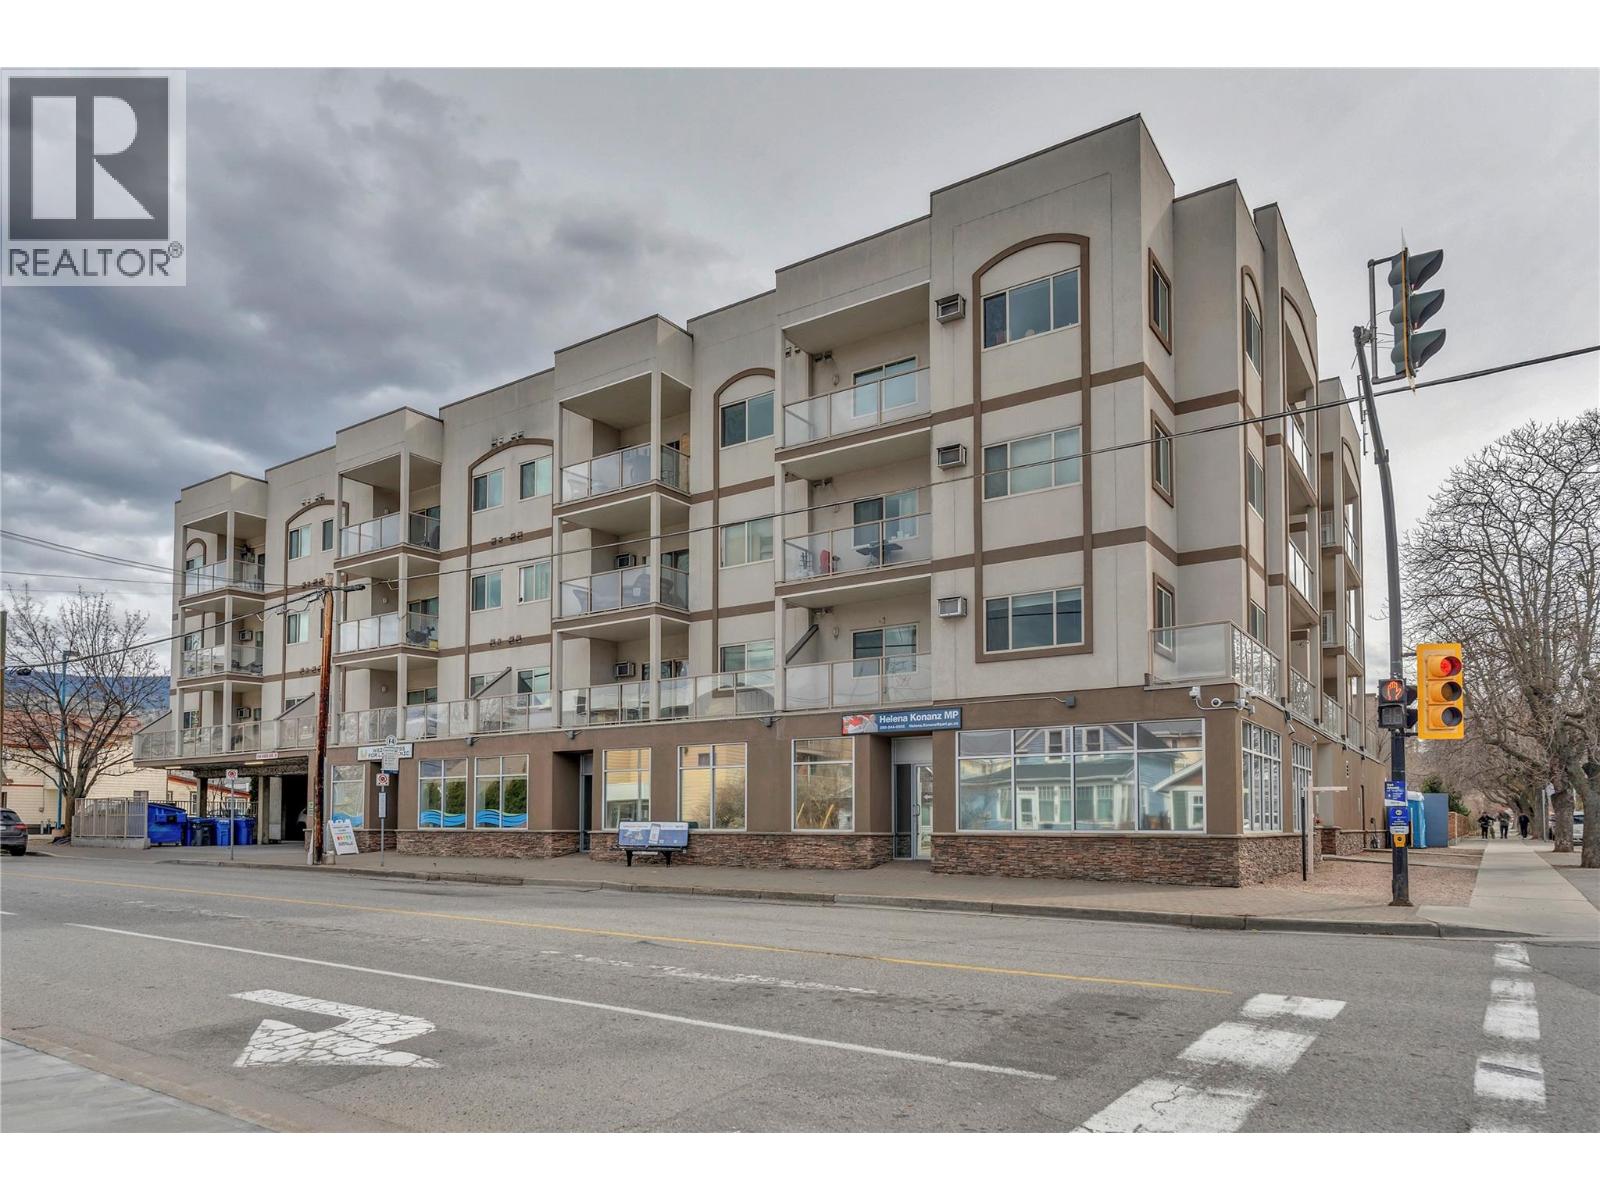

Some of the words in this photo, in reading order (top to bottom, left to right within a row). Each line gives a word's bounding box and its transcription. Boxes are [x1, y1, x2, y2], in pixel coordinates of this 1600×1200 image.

[879, 715, 908, 723] Helena
[910, 713, 942, 721] Konanz
[944, 711, 959, 719] MP
